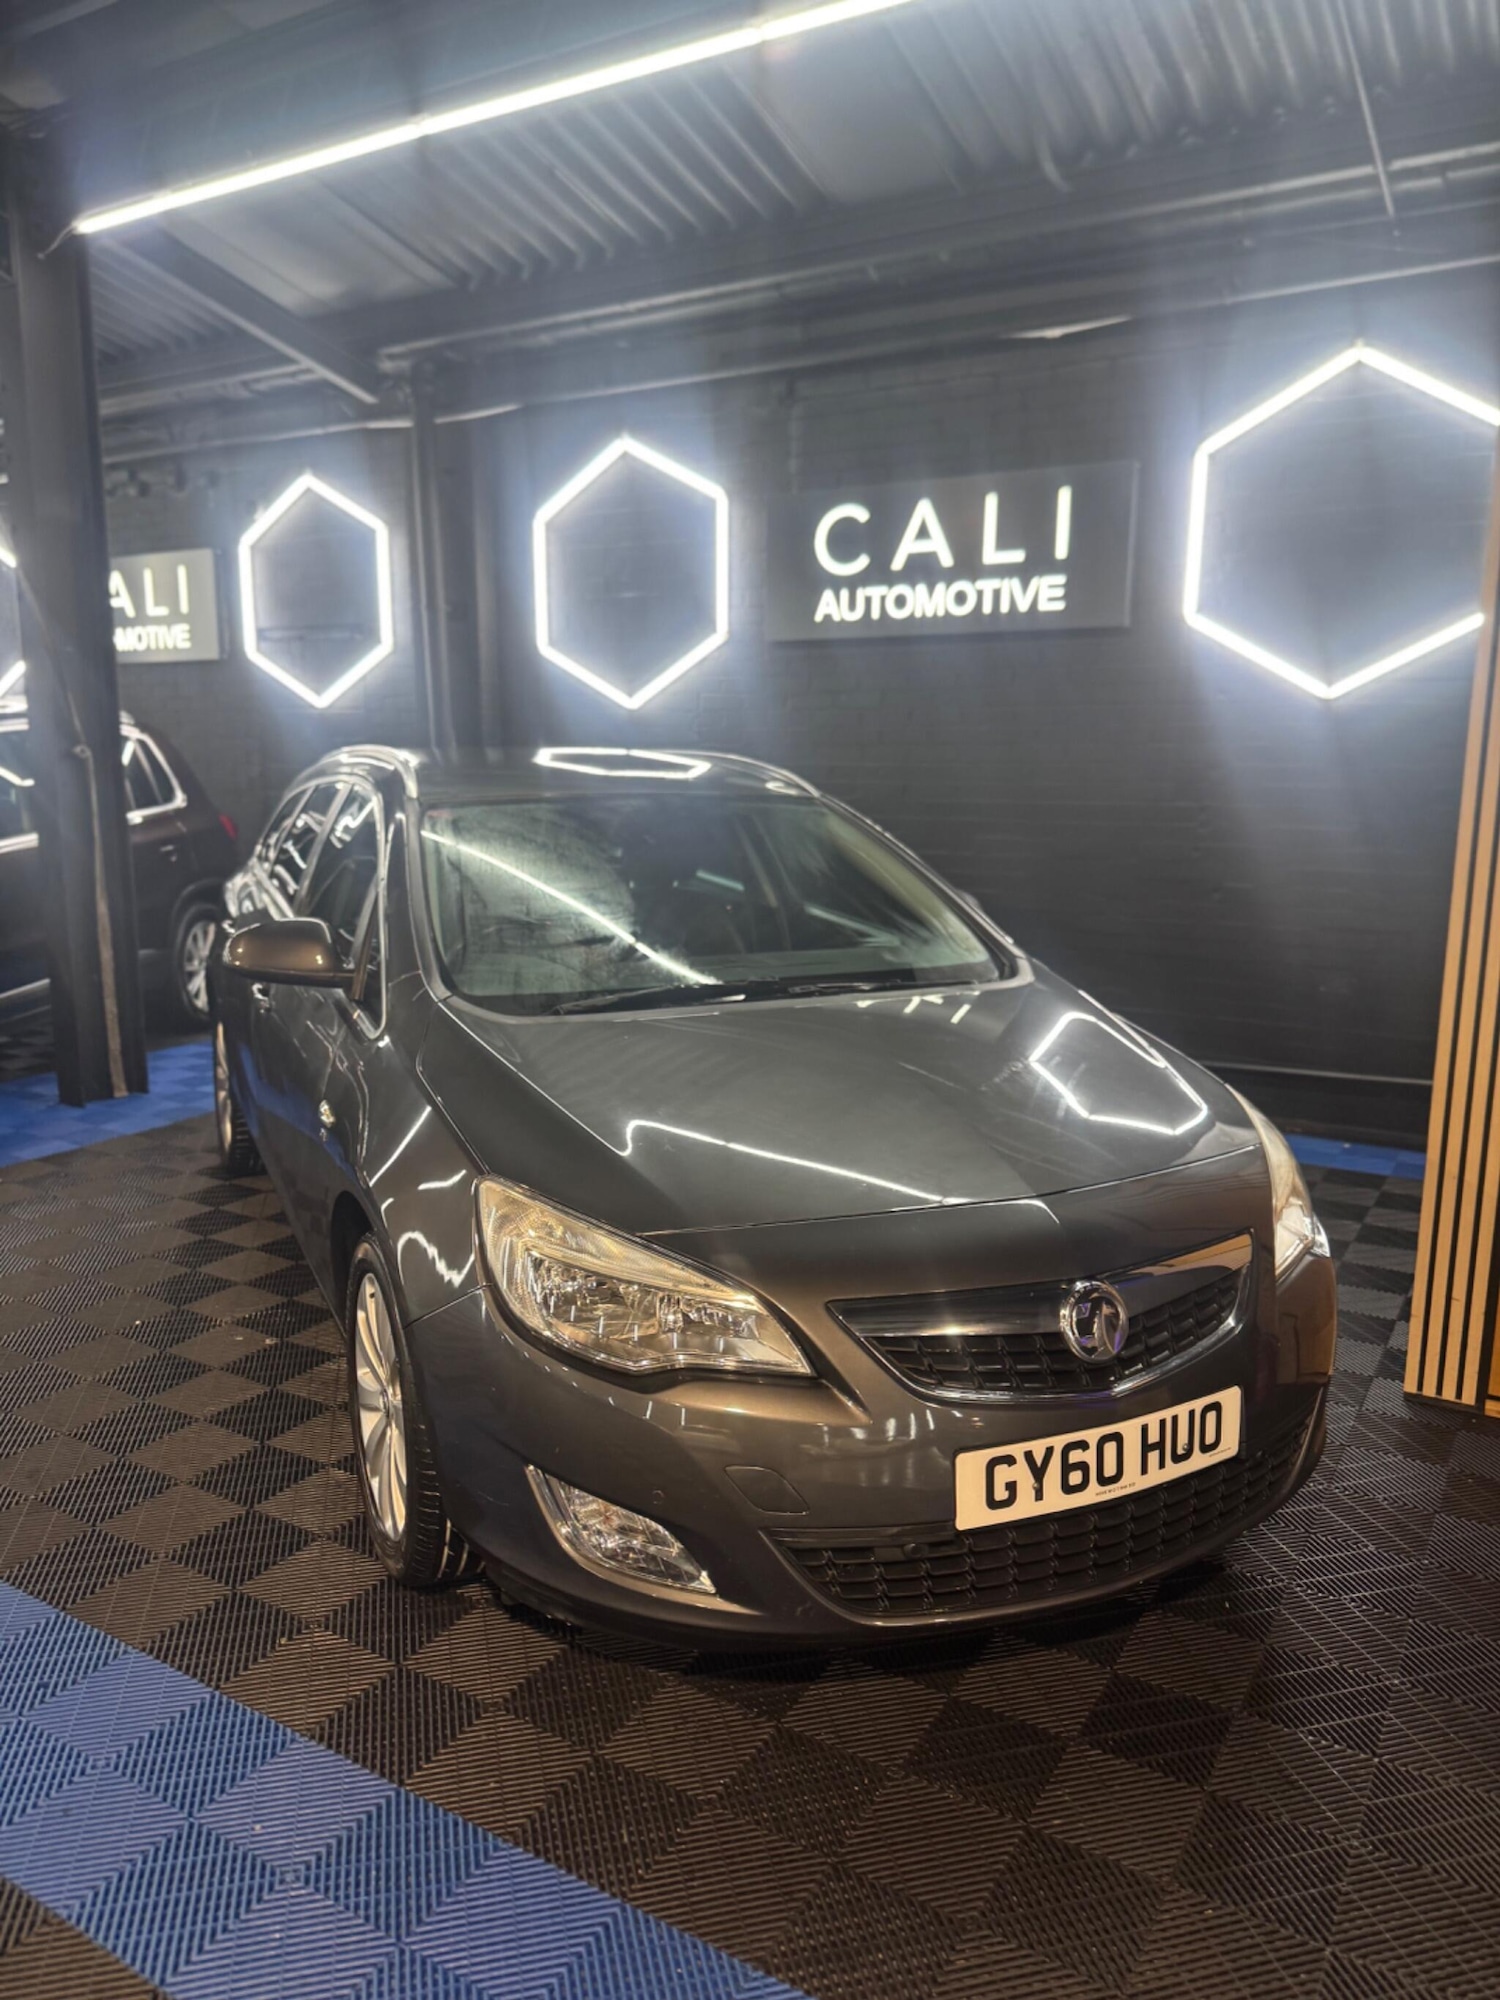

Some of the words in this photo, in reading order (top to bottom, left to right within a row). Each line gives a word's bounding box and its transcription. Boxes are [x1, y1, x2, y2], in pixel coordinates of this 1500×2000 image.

[814, 485, 1072, 576] CALI
[814, 574, 1067, 623] AUTOMOTIVE
[113, 623, 191, 652] MOTIVE
[985, 1431, 1124, 1510] GY60
[1141, 1401, 1222, 1476] HUO
